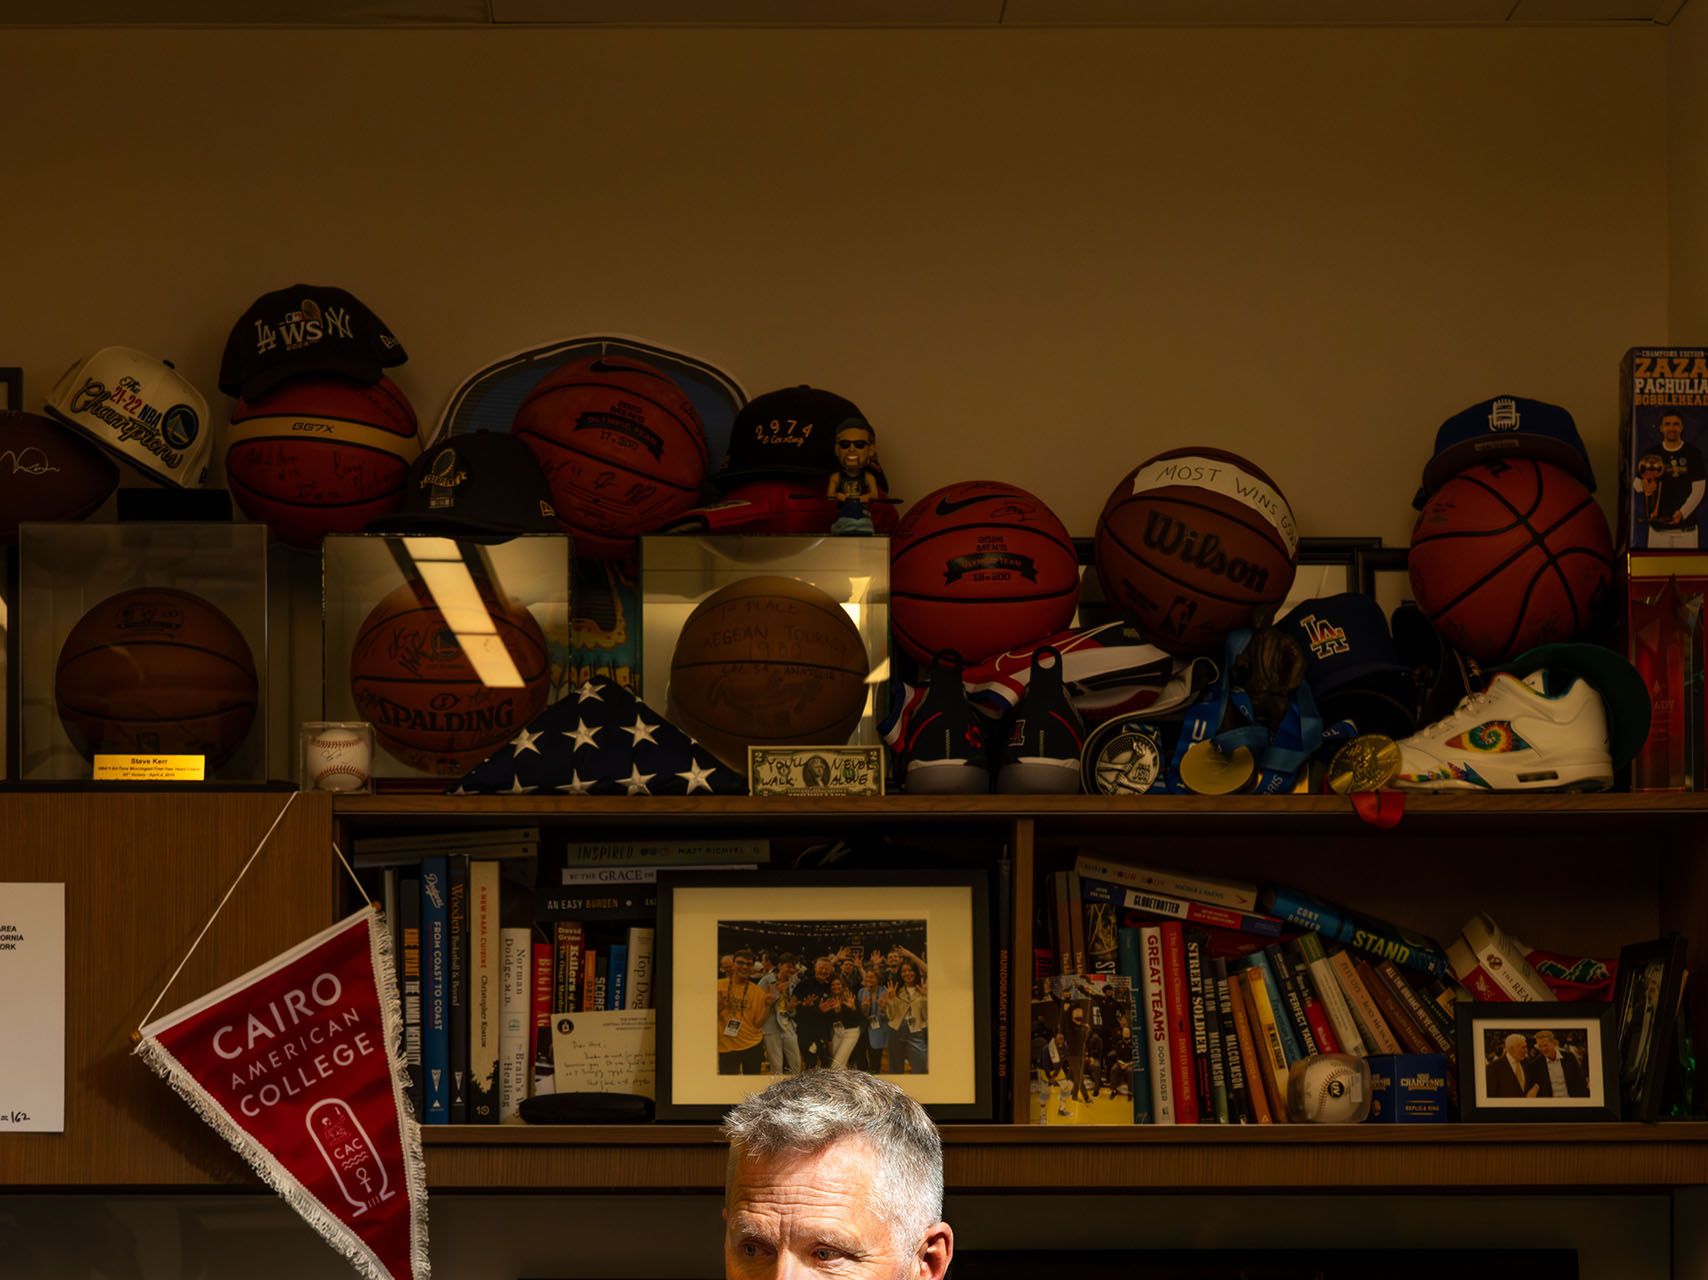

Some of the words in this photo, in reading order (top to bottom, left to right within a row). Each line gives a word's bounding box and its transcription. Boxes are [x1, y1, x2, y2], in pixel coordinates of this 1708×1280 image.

[278, 320, 323, 345] WS
[1635, 358, 1708, 377] ZAZA
[1635, 379, 1708, 393] PACHULIA
[71, 376, 184, 469] Champions
[111, 387, 142, 413] 21-22
[139, 404, 163, 429] NBA
[755, 418, 814, 441] 2974
[1155, 464, 1222, 482] MOST
[1235, 477, 1280, 516] WINS
[1143, 510, 1270, 593] Wilson
[1300, 614, 1351, 661] LA
[375, 697, 515, 734] SPALDING
[762, 777, 794, 786] WALK
[577, 846, 634, 861] INSPIRED
[598, 870, 643, 882] GRACE
[451, 883, 464, 933] Wooden
[561, 898, 583, 909] EASY
[433, 921, 442, 948] FROM
[1351, 929, 1411, 965] STAND
[433, 950, 442, 982] COAST
[516, 949, 525, 995] Norman
[569, 945, 579, 991] Killers
[634, 952, 651, 977] Top
[1147, 935, 1161, 986] GREAT
[1187, 941, 1201, 994] STREET
[1385, 966, 1397, 979] ALL
[1392, 976, 1405, 990] THE
[434, 984, 442, 997] TO
[537, 958, 550, 1001] BEGIN
[633, 982, 648, 1009] Dog
[1217, 978, 1228, 1000] WALK
[211, 972, 342, 1061] CAIRO
[434, 999, 443, 1030] COAST
[1149, 987, 1165, 1042] TEAMS
[1191, 996, 1208, 1054] SOLDIER
[1221, 1001, 1231, 1014] ON
[1287, 991, 1309, 1029] PERFECT
[230, 1007, 361, 1091] AMERICAN
[1225, 1034, 1244, 1089] MALCOLMSON
[239, 1031, 375, 1118] COLLEGE
[503, 1062, 513, 1107] Healing
[515, 1053, 524, 1092] Brain's
[1399, 1077, 1445, 1088] CHAMPIONS
[11, 1111, 31, 1123] 162
[333, 1137, 364, 1160] CAC
